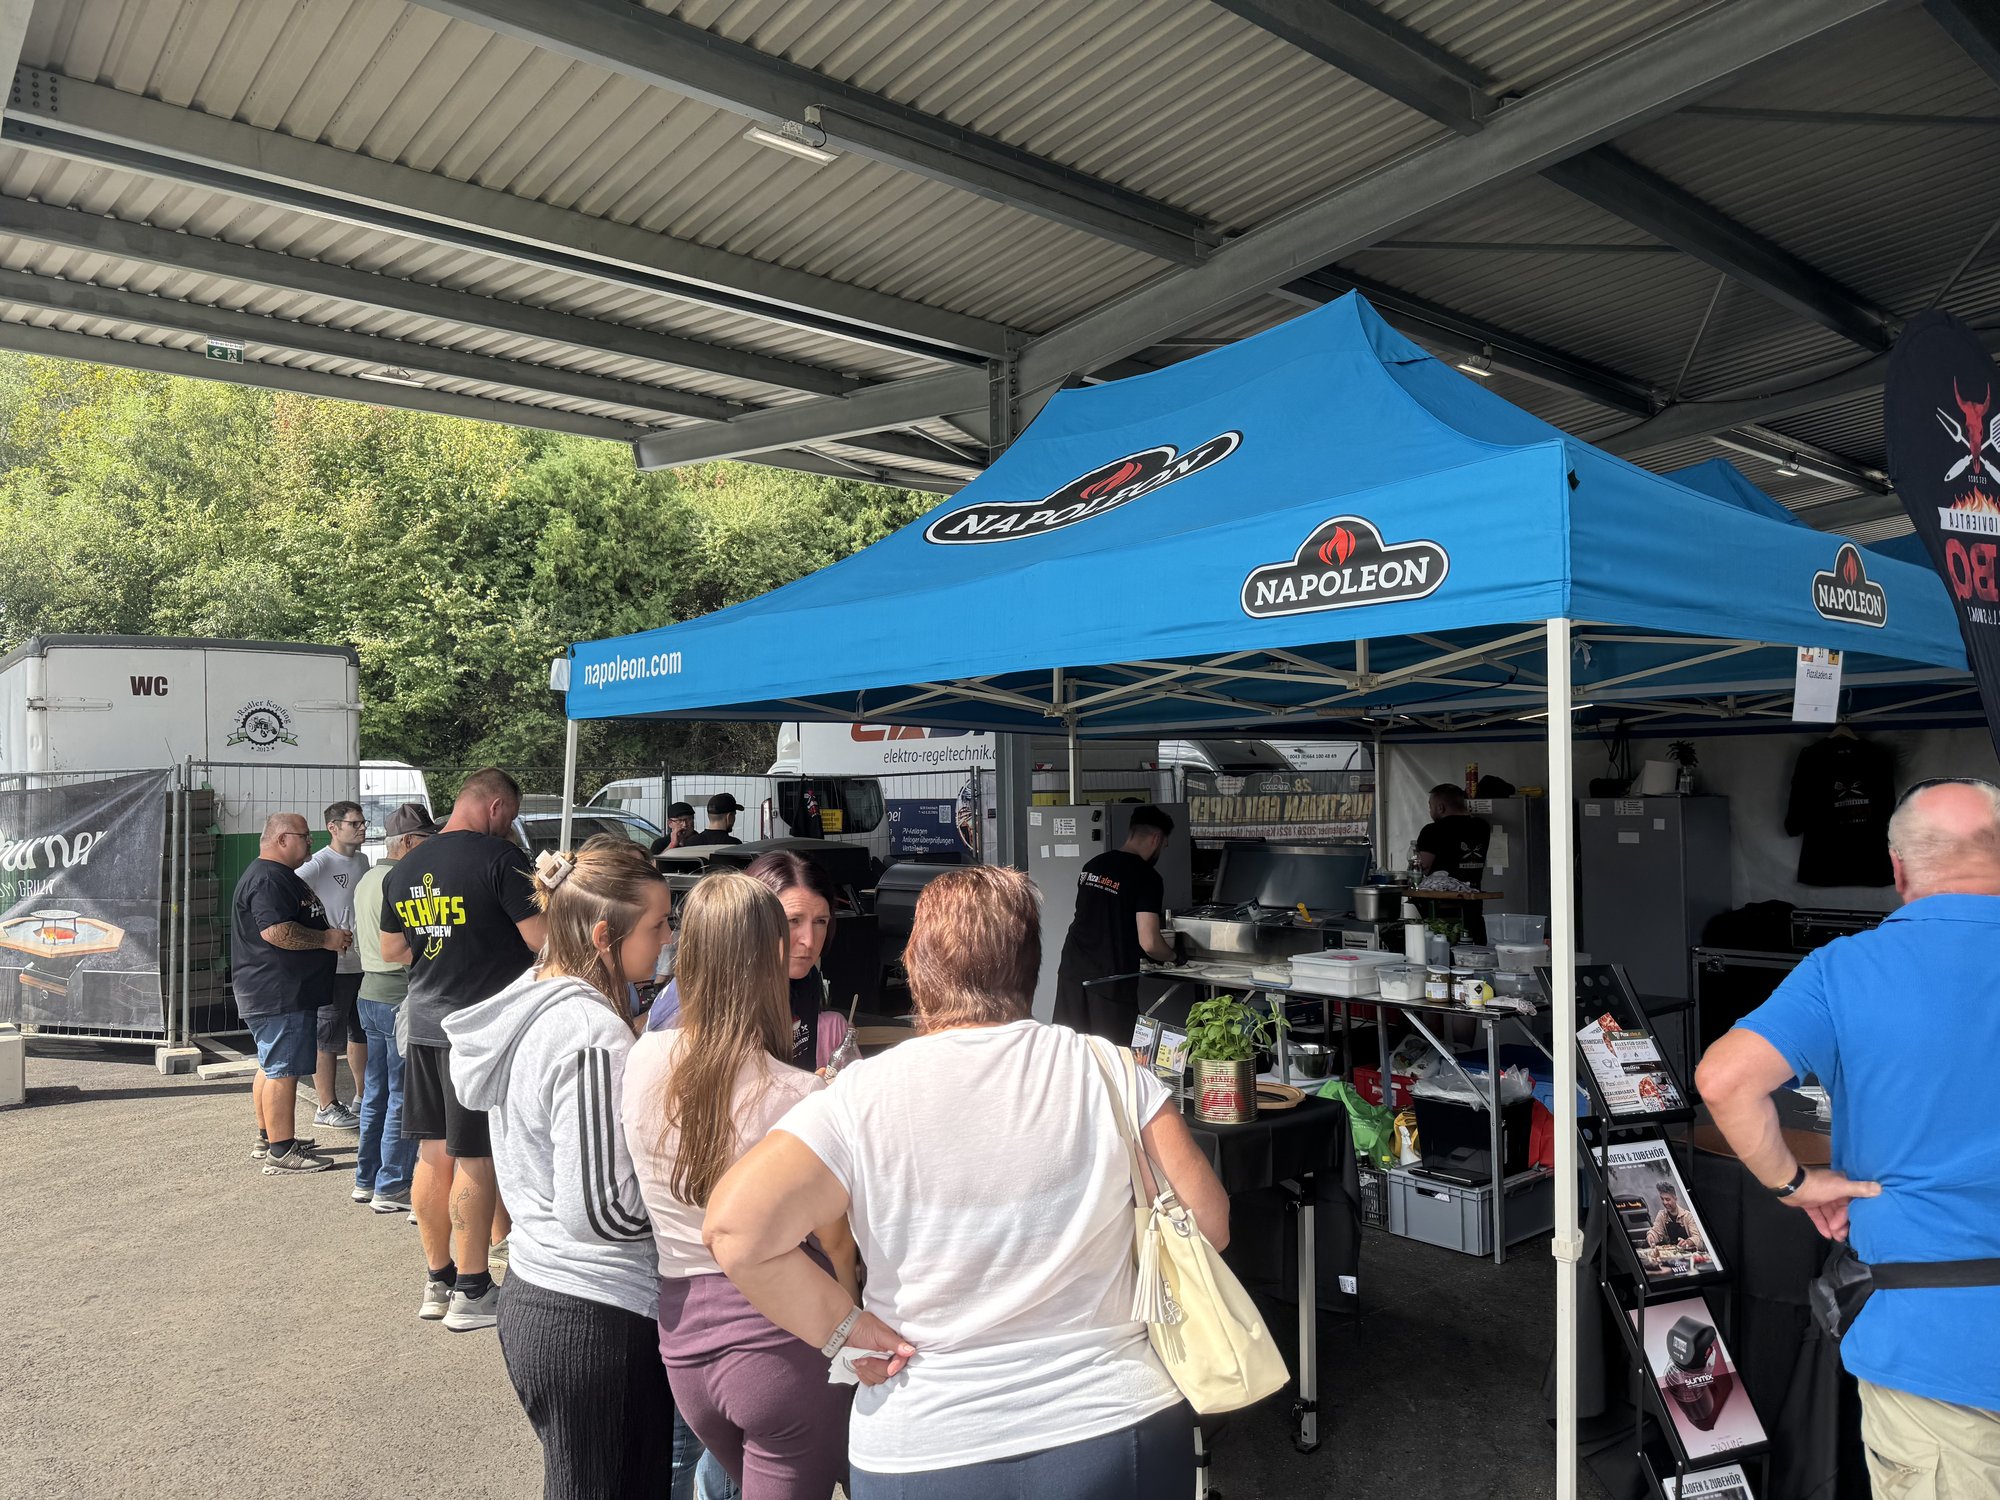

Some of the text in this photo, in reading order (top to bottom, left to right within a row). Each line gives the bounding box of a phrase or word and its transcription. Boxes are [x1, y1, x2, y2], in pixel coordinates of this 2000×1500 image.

[945, 446, 1214, 535] NAPOLEON
[1254, 556, 1430, 607] NAPOLEON
[1817, 583, 1883, 618] NAPOLEON
[584, 651, 682, 690] napoleon.com
[129, 675, 169, 697] WC
[233, 699, 291, 725] 4-Radler Kopfing
[409, 885, 427, 899] TEIL
[1625, 1152, 1632, 1162] &
[1632, 1146, 1666, 1161] ZUBEHÖR
[1685, 1373, 1714, 1386] sunmix
[1704, 1480, 1710, 1491] &
[1709, 1472, 1743, 1490] ZUBEHÖR
